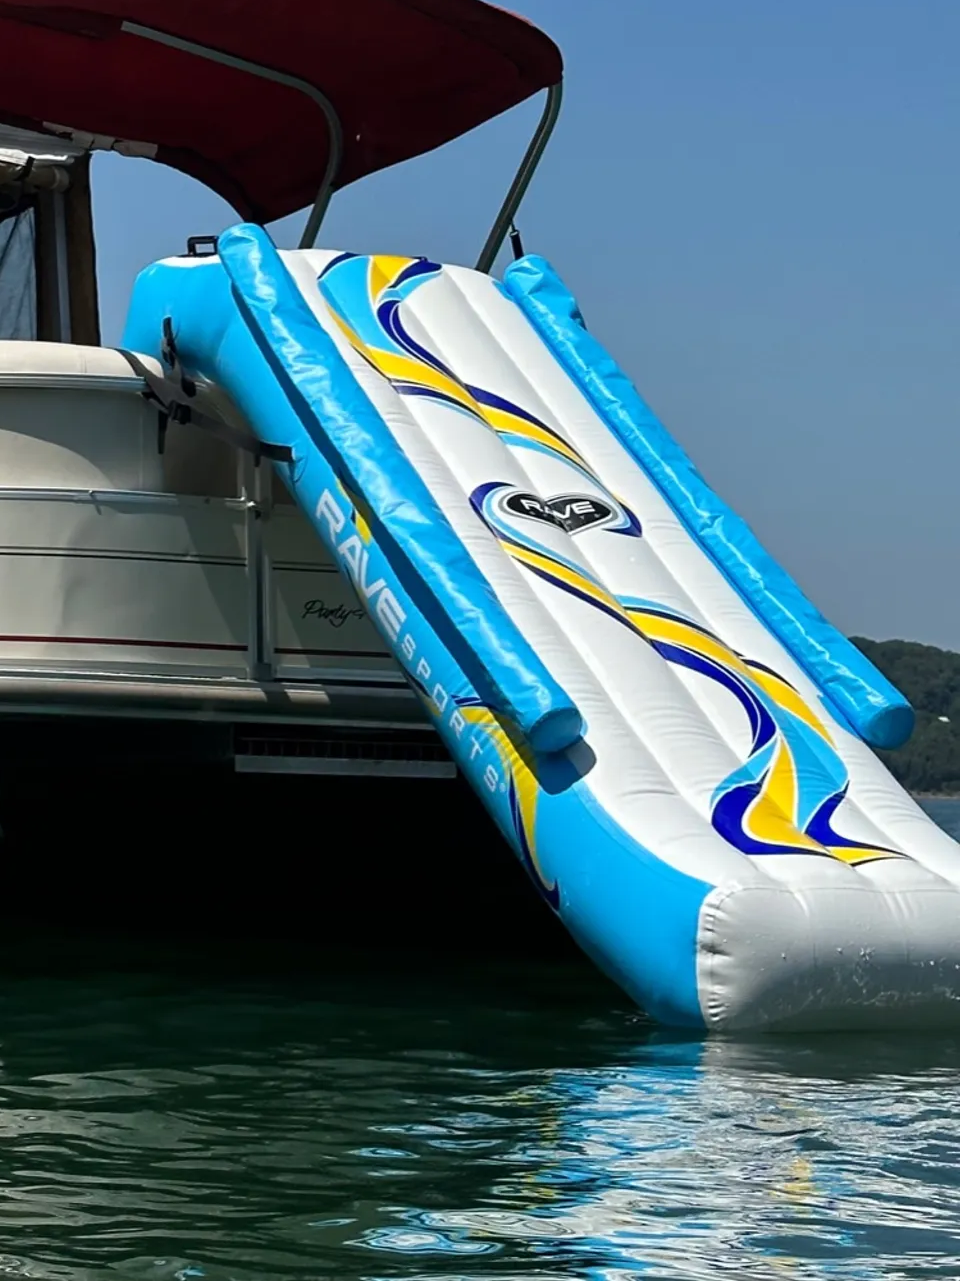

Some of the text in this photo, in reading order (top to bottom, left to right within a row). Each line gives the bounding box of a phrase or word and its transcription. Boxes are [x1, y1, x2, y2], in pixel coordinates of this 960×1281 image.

[520, 499, 596, 520] RAVE
[316, 489, 498, 793] RAVE SPORTS
